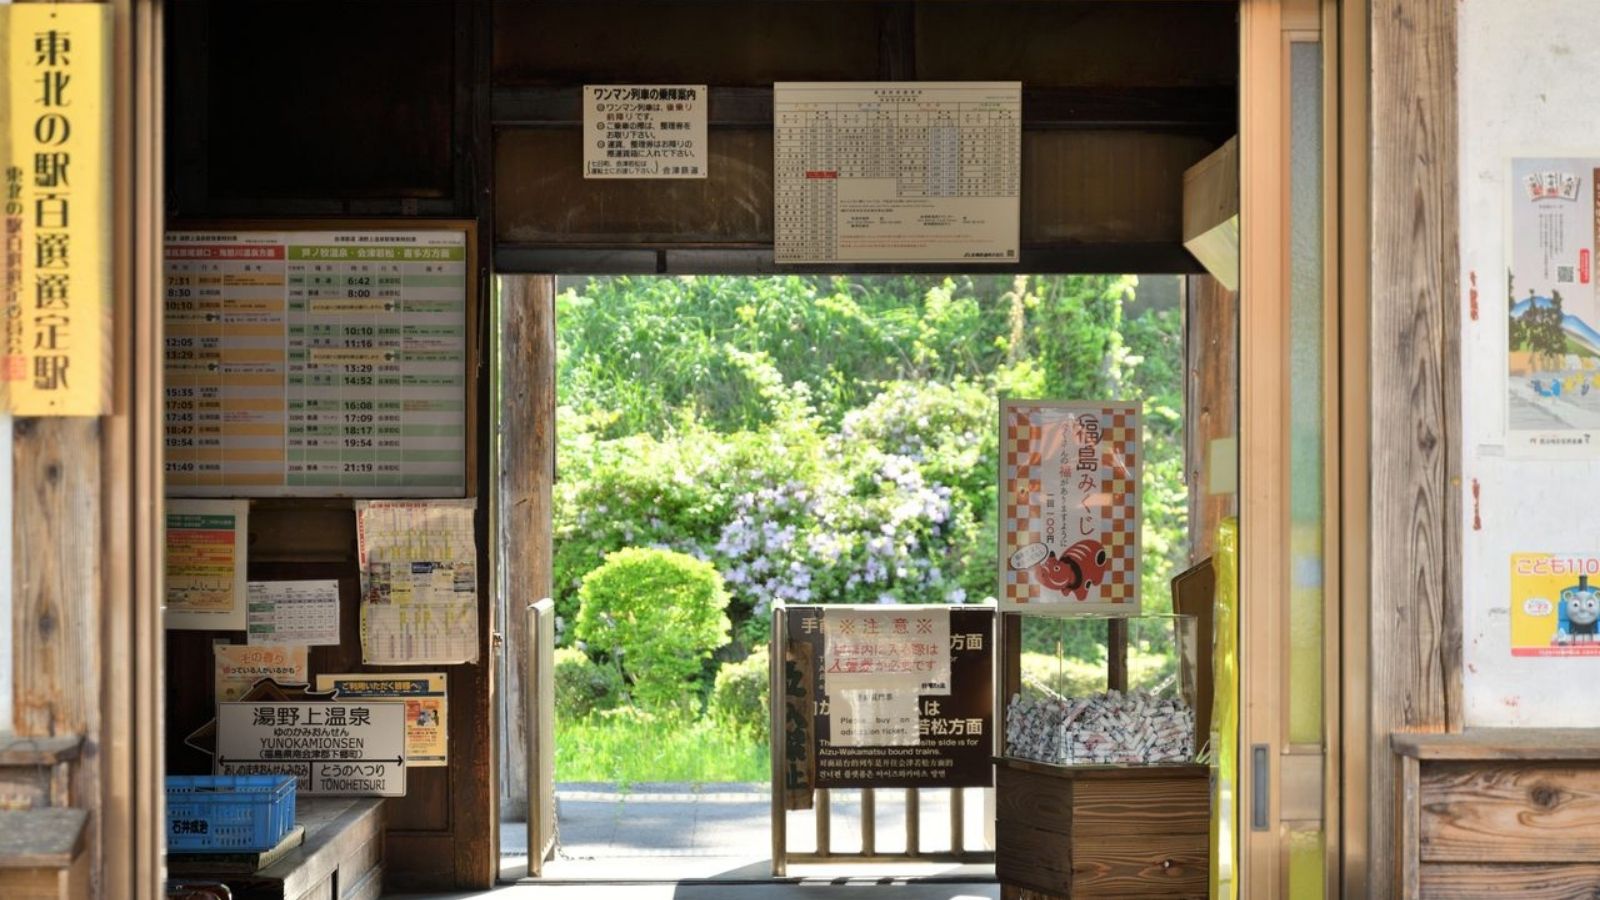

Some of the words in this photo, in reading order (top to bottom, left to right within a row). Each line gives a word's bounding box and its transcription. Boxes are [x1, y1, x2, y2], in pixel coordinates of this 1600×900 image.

[34, 30, 71, 390] 東北の駅百選選定駅
[348, 277, 370, 286] 6:42
[348, 289, 370, 298] 8:00
[344, 327, 373, 336] 10:10
[344, 364, 373, 373] 13:29
[344, 376, 373, 385] 14:52
[344, 414, 373, 422] 17:09
[344, 426, 372, 435] 18:17
[166, 438, 193, 447] 19:54
[344, 439, 373, 447] 19:54
[344, 463, 373, 472] 21:19
[1518, 558, 1600, 575] こども110
[253, 707, 372, 727] 湯野上温泉
[274, 728, 349, 737] ゆのかみおんせん
[261, 738, 364, 749] YUNOKAMIONSEN
[938, 739, 956, 747] side
[967, 739, 979, 747] for
[819, 748, 886, 756] Aizu-Wakamatsu
[888, 748, 913, 756] bound
[915, 748, 940, 756] trains.
[320, 765, 385, 776] とうのへつり
